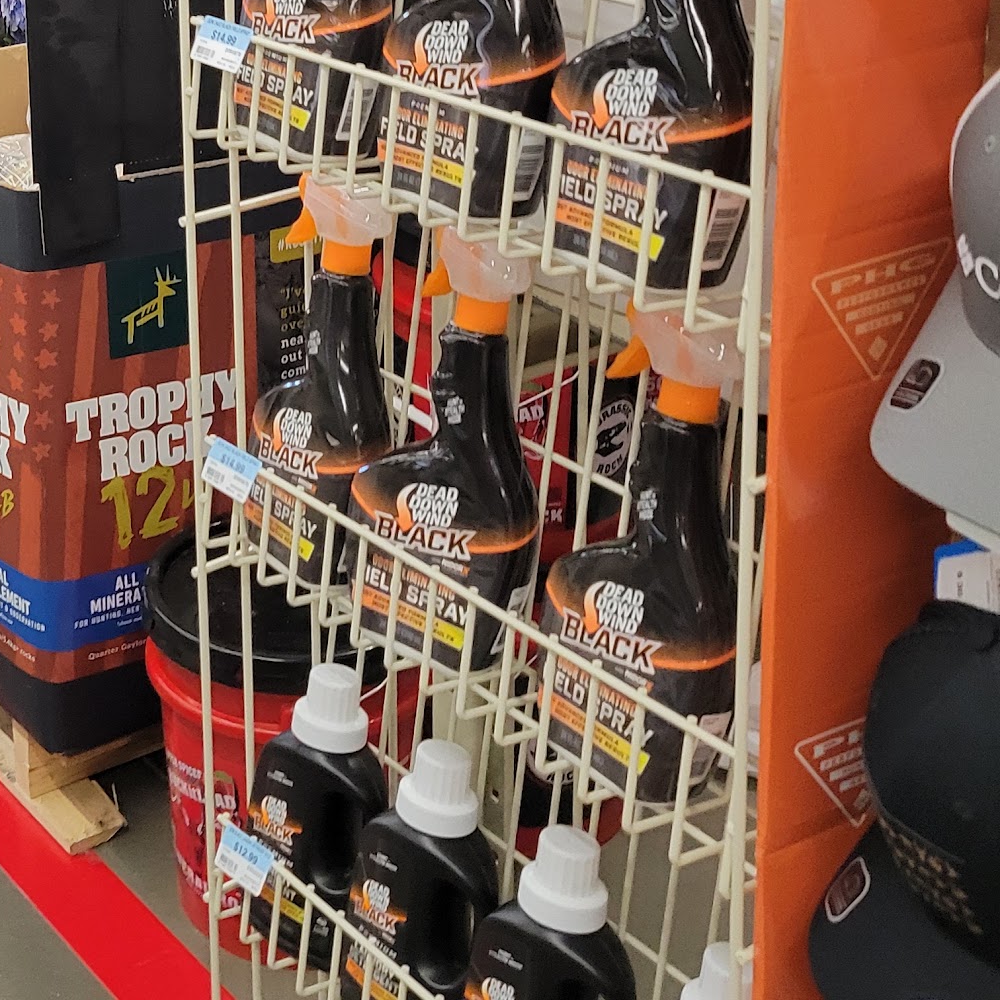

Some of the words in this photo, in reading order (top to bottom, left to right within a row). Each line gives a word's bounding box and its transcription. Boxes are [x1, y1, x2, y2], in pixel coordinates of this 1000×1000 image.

[275, 1, 304, 15] WIND
[210, 29, 237, 46] $14.99
[251, 12, 321, 44] BLACK
[431, 19, 469, 36] DEAD
[424, 34, 469, 50] DOWN
[427, 48, 463, 64] WIND
[237, 64, 265, 89] FIED
[266, 77, 314, 108] SPAY
[396, 59, 484, 96] BLACK
[612, 67, 658, 87] DEAD
[605, 83, 658, 102] DOWN
[607, 99, 651, 117] WIND
[570, 110, 676, 154] BLACK
[421, 128, 479, 163] SPRA
[560, 175, 597, 205] IELD
[280, 335, 304, 349] nea
[280, 351, 303, 366] out
[65, 368, 240, 443] TROPHY
[285, 407, 312, 425] DEAD
[281, 418, 312, 440] DOWN
[282, 429, 309, 449] WIND
[99, 414, 214, 482] ROCK
[259, 432, 323, 480] BLACK
[409, 494, 459, 514] DOWN
[415, 482, 459, 502] DEAD
[100, 465, 180, 549] 12
[411, 507, 452, 528] WIND
[273, 500, 318, 540] SPAY
[375, 510, 476, 561] BLACK
[115, 572, 140, 591] ALL
[602, 580, 645, 606] DEAD
[596, 595, 645, 622] DOWN
[74, 616, 89, 631] FOR
[597, 610, 639, 634] WIND
[88, 645, 119, 662] Quarter
[120, 638, 147, 654] Gaylor
[561, 607, 665, 676] BLACK
[554, 673, 586, 706] ELD
[232, 841, 259, 865] $12.99
